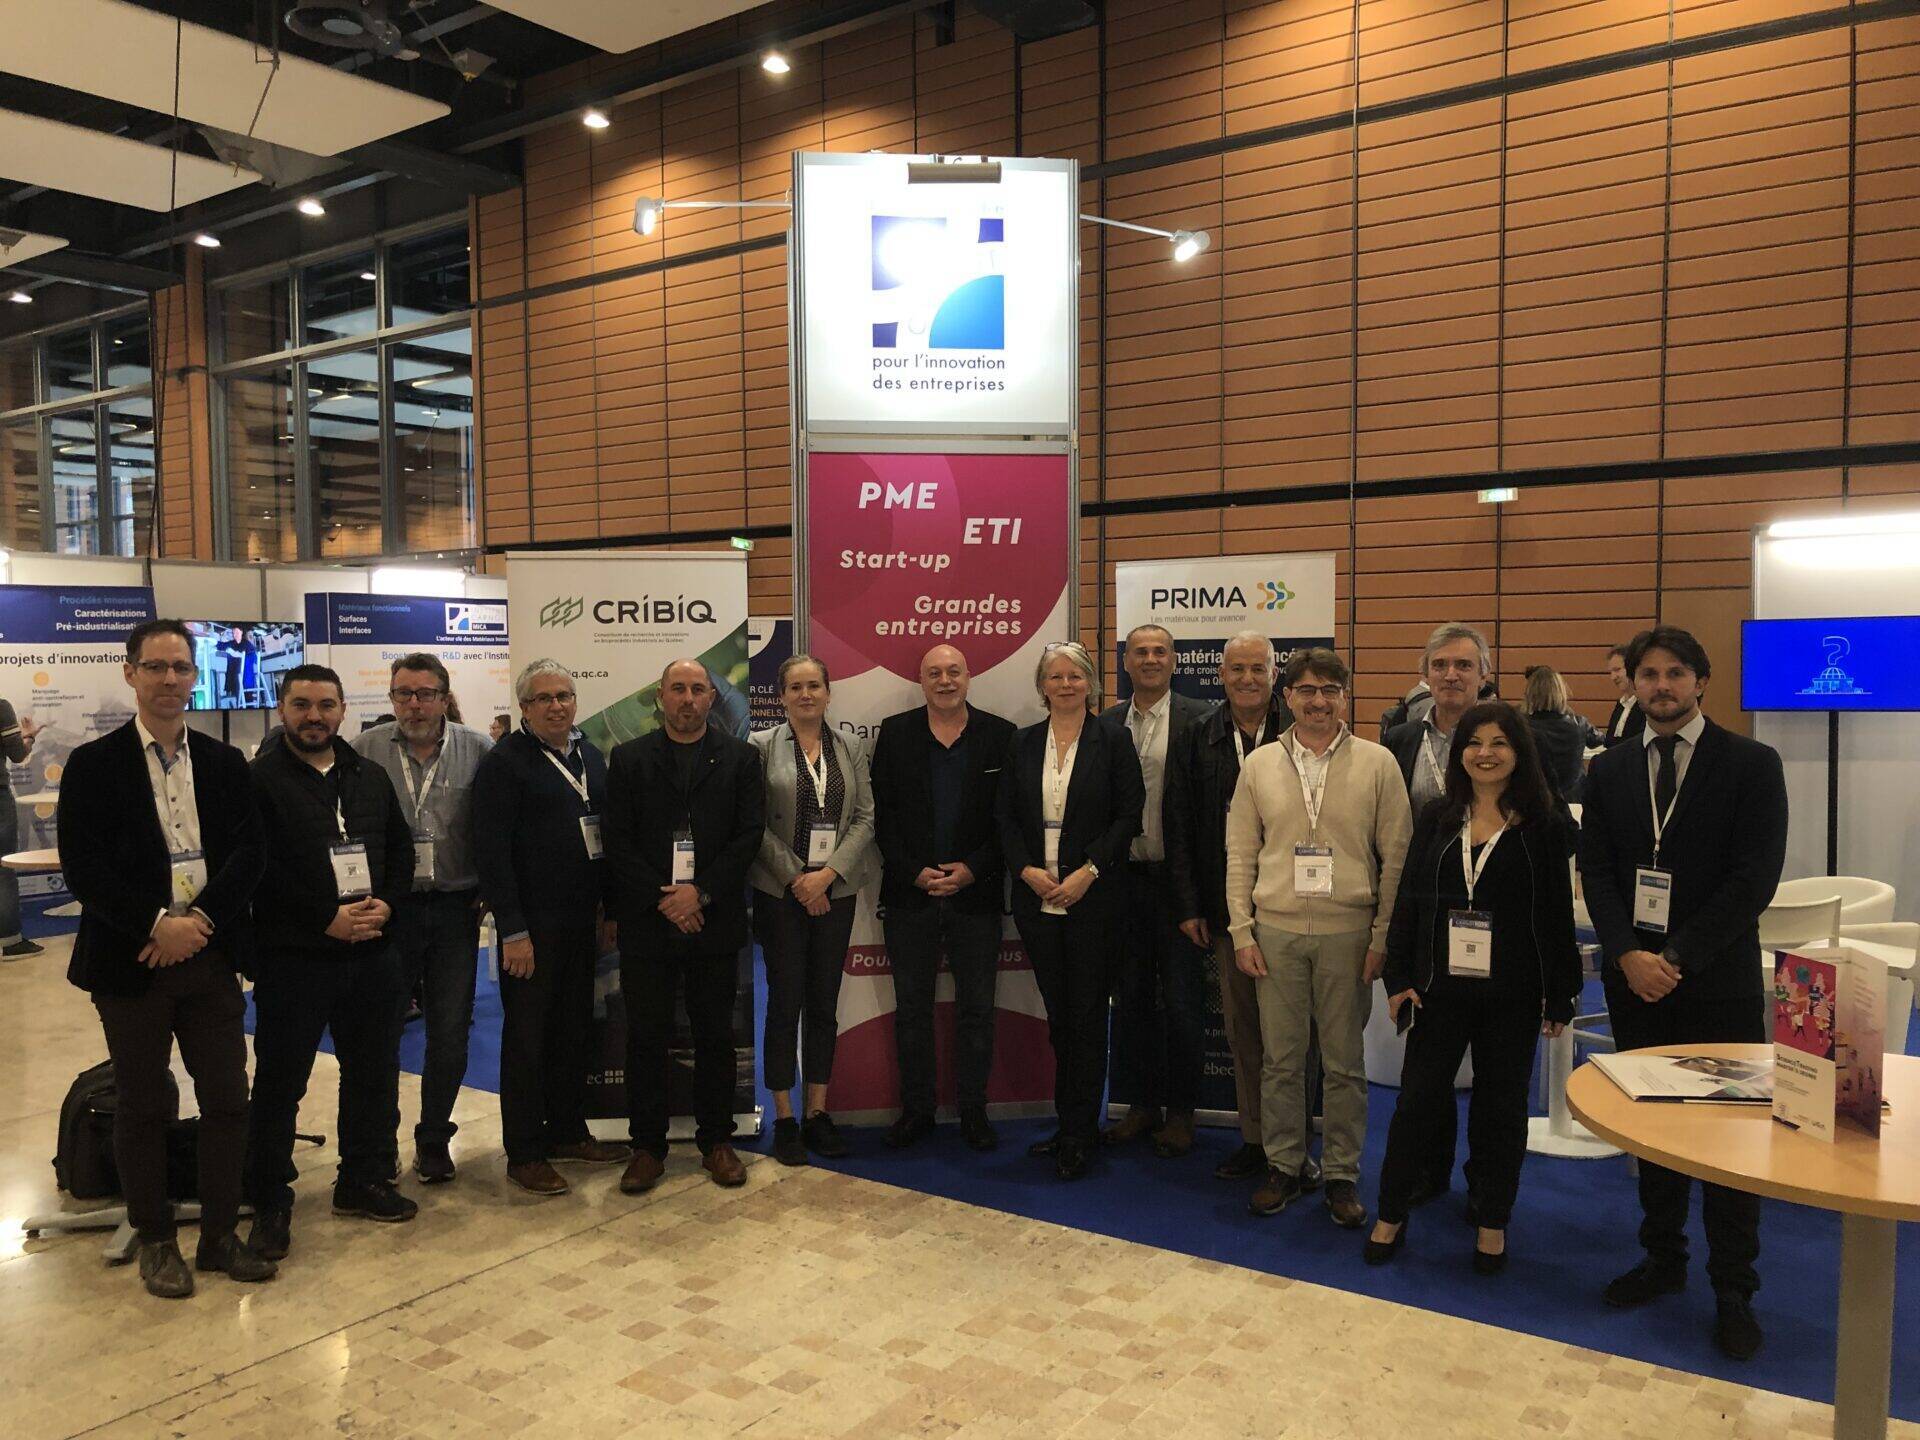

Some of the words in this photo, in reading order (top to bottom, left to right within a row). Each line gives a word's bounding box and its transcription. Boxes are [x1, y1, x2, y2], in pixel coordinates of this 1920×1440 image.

[873, 355, 908, 371] pour
[914, 354, 1005, 370] l'innovation
[873, 374, 902, 390] des
[910, 376, 1005, 393] entreprises
[858, 482, 938, 510] PME
[963, 518, 1022, 545] ETI
[840, 550, 950, 573] Start-up
[914, 593, 1022, 615] Grandes
[1151, 586, 1247, 610] PRIMA
[75, 608, 146, 618] Caractérisations
[338, 614, 368, 623] Surfaces
[56, 621, 136, 631] Pré-industrialisati
[338, 626, 372, 634] Interfaces
[875, 615, 1022, 639] entreprises
[382, 651, 407, 660] Boost
[484, 651, 510, 660] l'Instit
[1176, 649, 1224, 664] atéria
[571, 670, 609, 679] q.qc.ca
[1184, 666, 1195, 675] de
[1197, 666, 1218, 675] crois
[757, 684, 774, 694] CLÉ
[1200, 678, 1211, 686] au
[840, 721, 882, 739] Dan
[852, 953, 891, 968] Pou
